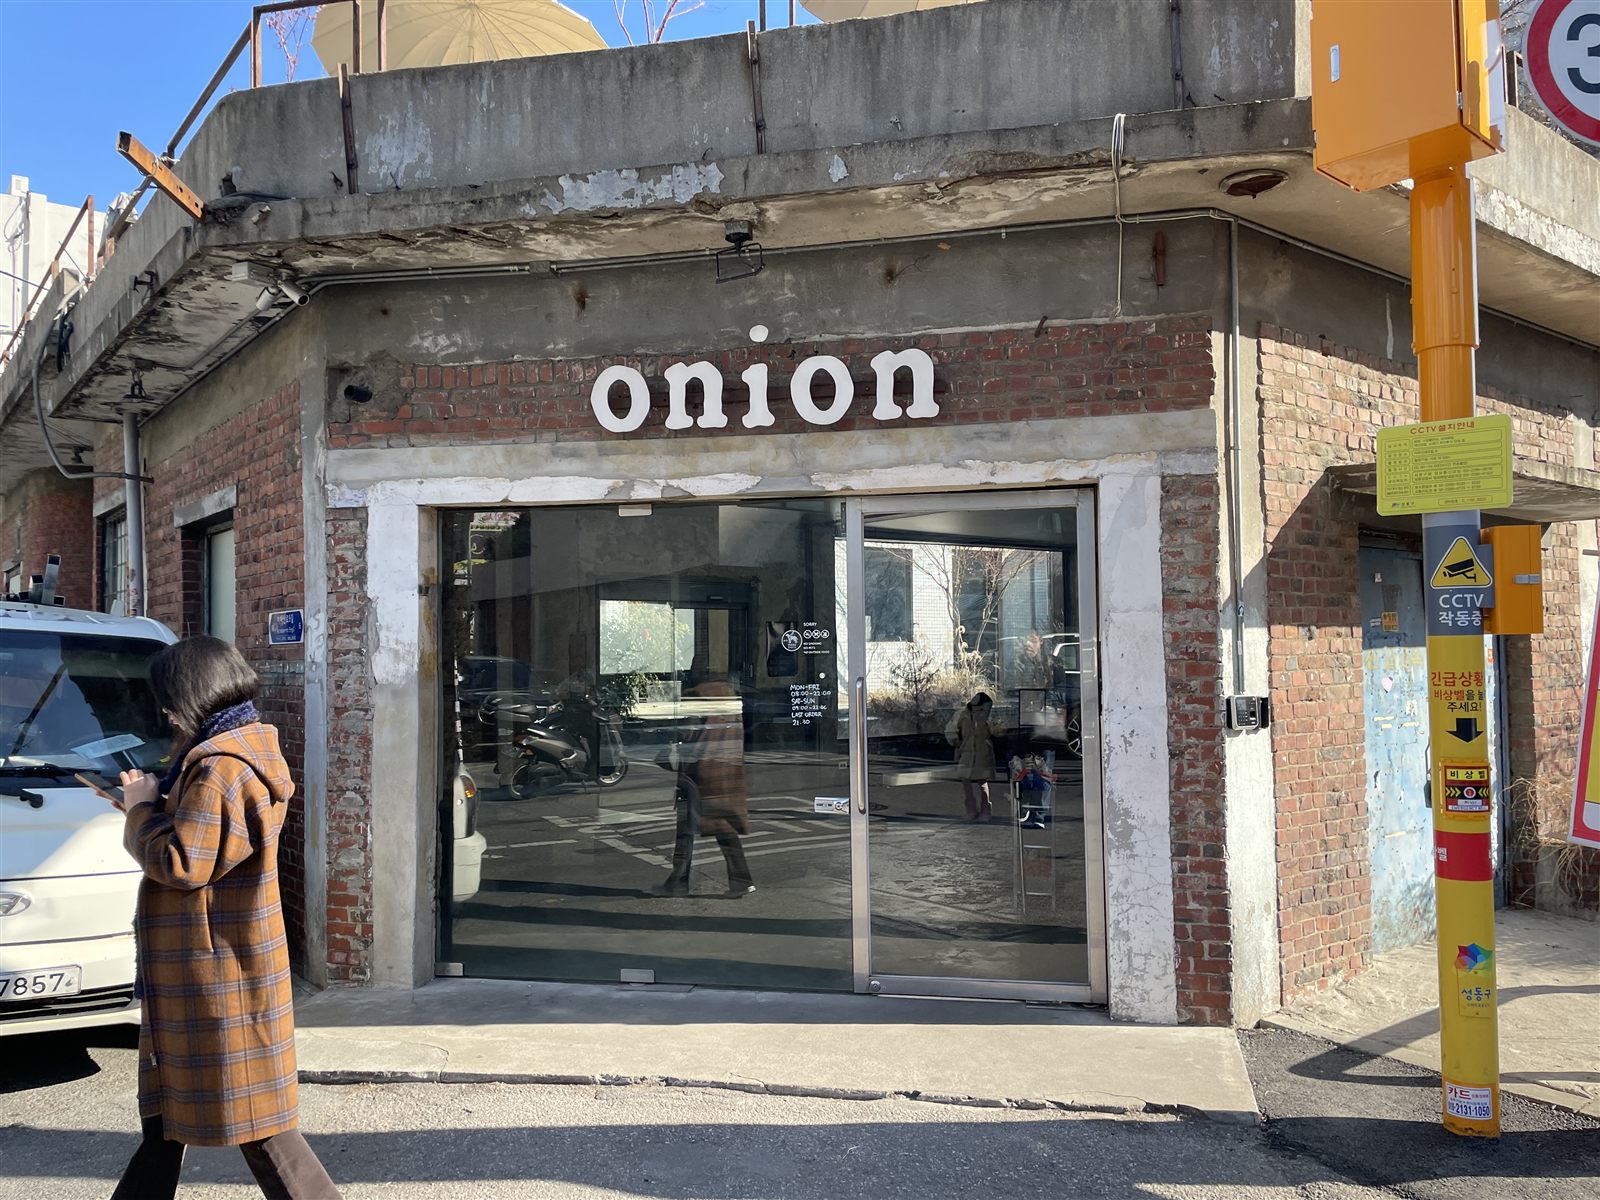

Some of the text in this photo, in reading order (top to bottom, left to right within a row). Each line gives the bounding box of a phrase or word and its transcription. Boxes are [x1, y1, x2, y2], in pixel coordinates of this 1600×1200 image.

[591, 324, 940, 432] onion
[1410, 426, 1437, 435] CCTV
[1439, 593, 1484, 608] CCTV
[1439, 610, 1483, 627] 작동중
[1431, 671, 1483, 687] 긴급상황
[0, 972, 65, 997] 7857
[1461, 987, 1491, 1002] 성동구
[1448, 1086, 1472, 1100] 카드
